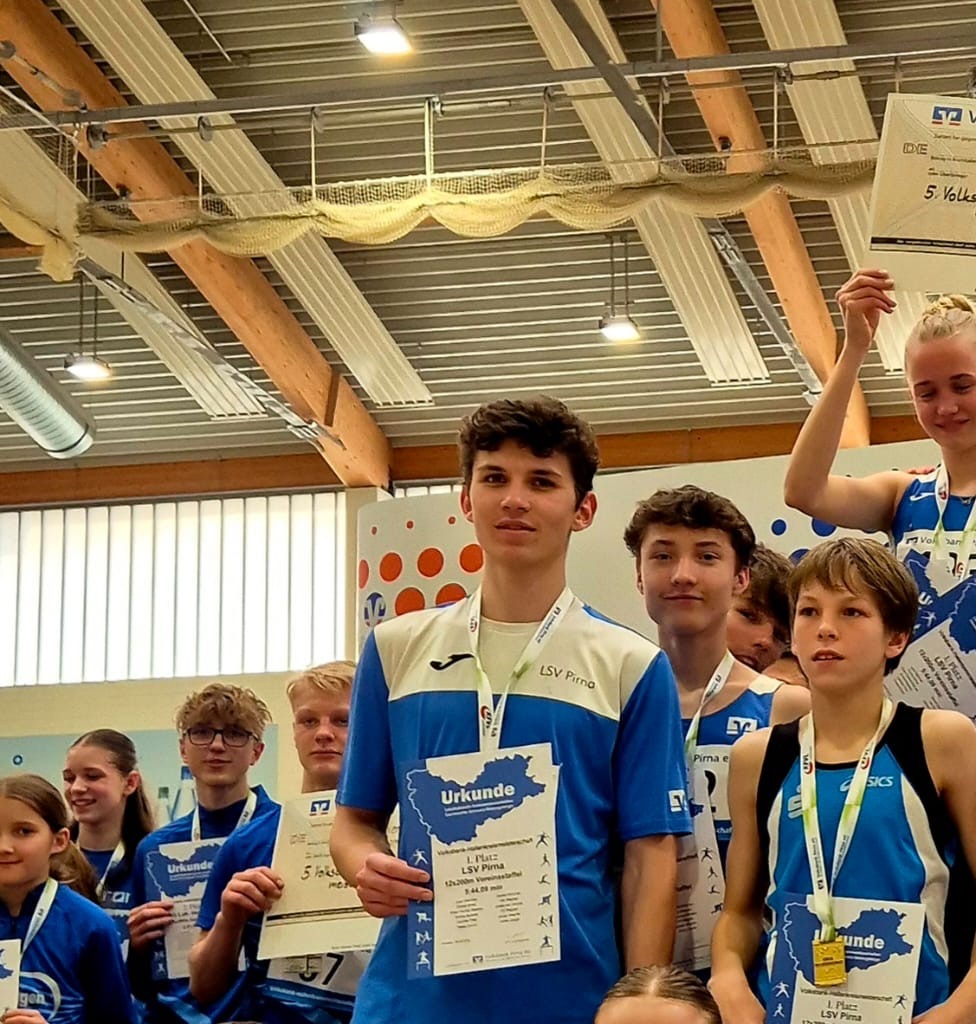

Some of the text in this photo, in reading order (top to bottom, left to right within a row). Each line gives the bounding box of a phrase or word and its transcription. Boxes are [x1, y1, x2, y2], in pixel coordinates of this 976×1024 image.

[903, 143, 928, 154] DE
[540, 665, 596, 689] LSV Pirna
[693, 753, 719, 763] Pirna
[866, 776, 894, 788] SICS
[441, 783, 515, 804] Urkunde
[461, 862, 505, 875] LSV Pirna
[820, 1009, 862, 1021] LSV Pirna
